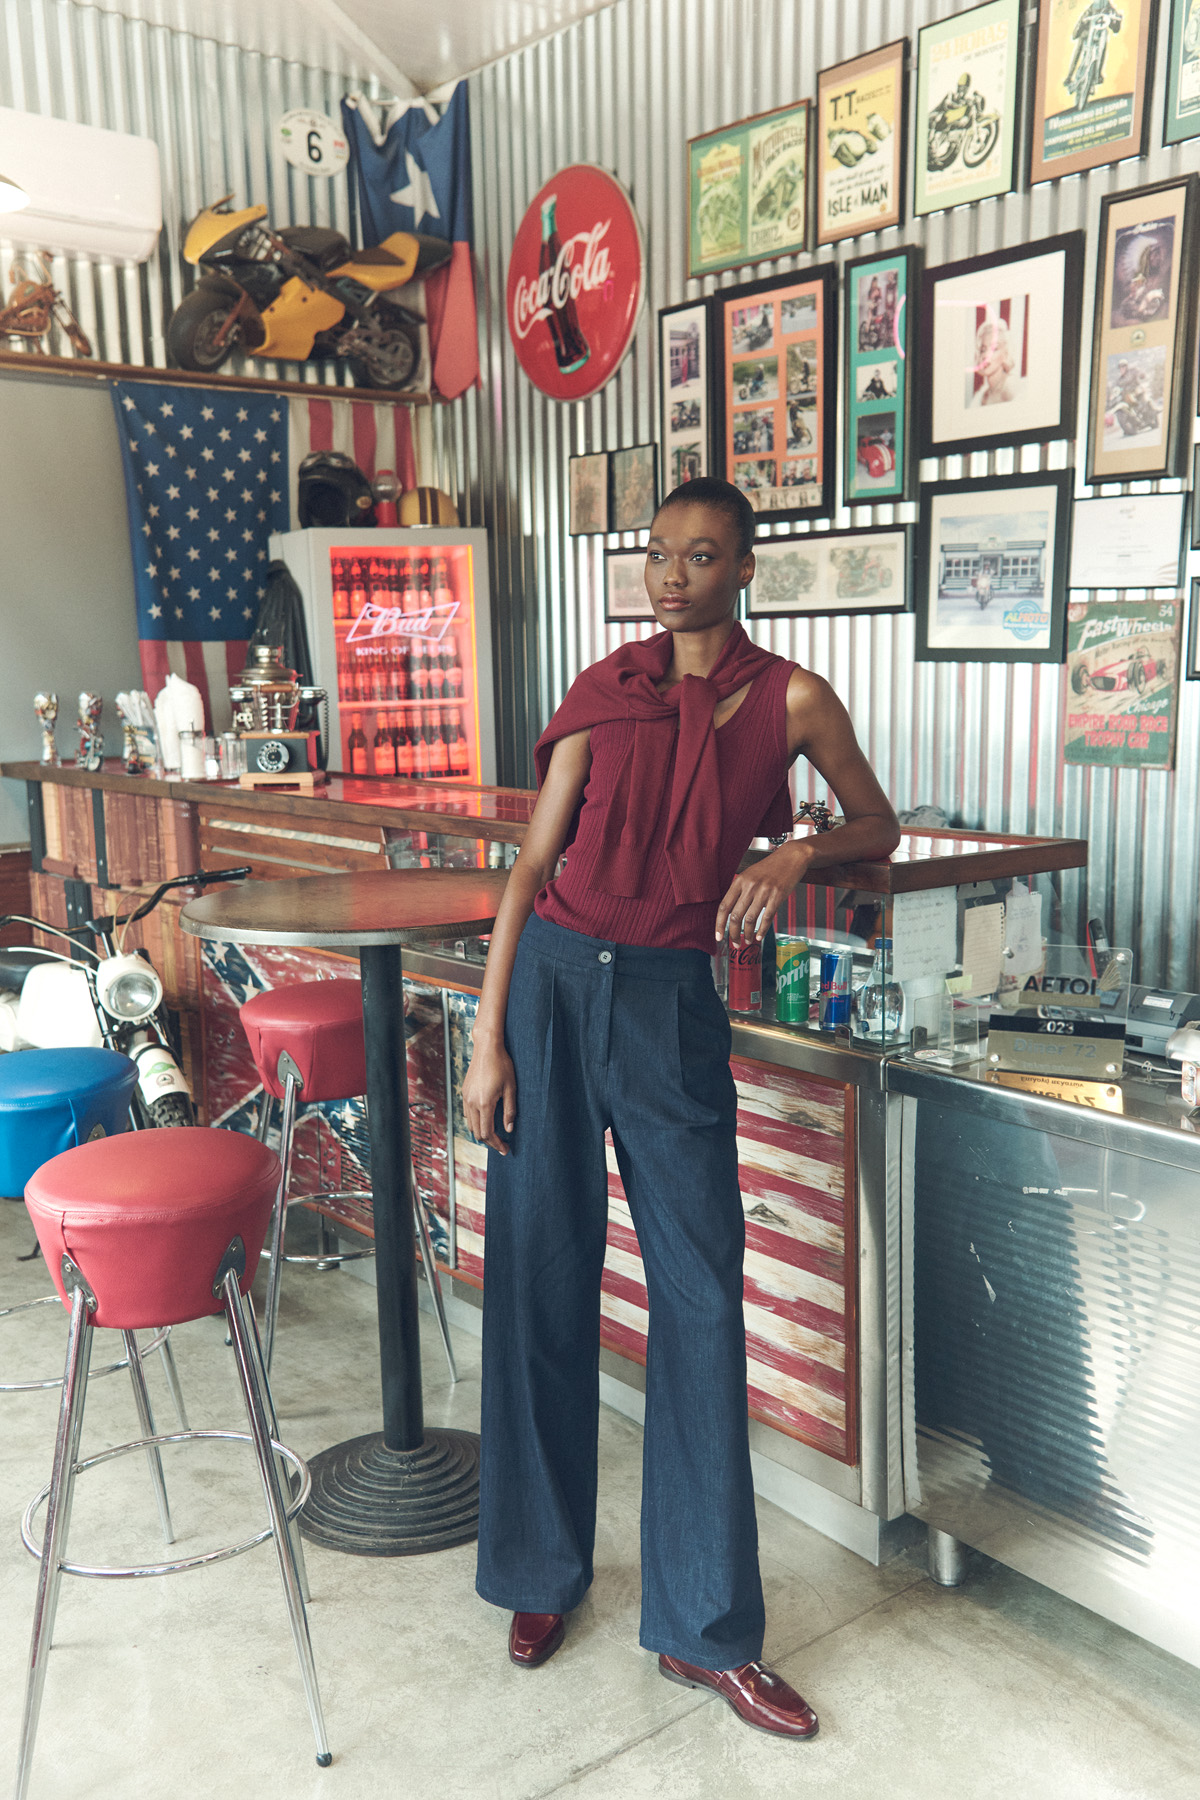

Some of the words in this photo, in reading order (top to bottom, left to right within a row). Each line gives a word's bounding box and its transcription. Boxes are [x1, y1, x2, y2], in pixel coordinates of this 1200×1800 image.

[954, 21, 1009, 57] HORAS
[307, 131, 322, 163] 6
[828, 195, 852, 217] ISLE
[861, 182, 888, 206] MAN
[514, 218, 613, 339] Coca-Cola
[365, 606, 433, 634] Bud
[1159, 604, 1173, 617] 34
[355, 646, 388, 656] KING
[1068, 713, 1106, 730] EMPIRE
[1140, 714, 1169, 732] RACE
[1084, 730, 1126, 747] TROPHY
[831, 981, 848, 991] Bull
[1038, 1020, 1074, 1034] 2023
[1013, 1038, 1066, 1056] Diner
[1072, 1043, 1098, 1058] 72
